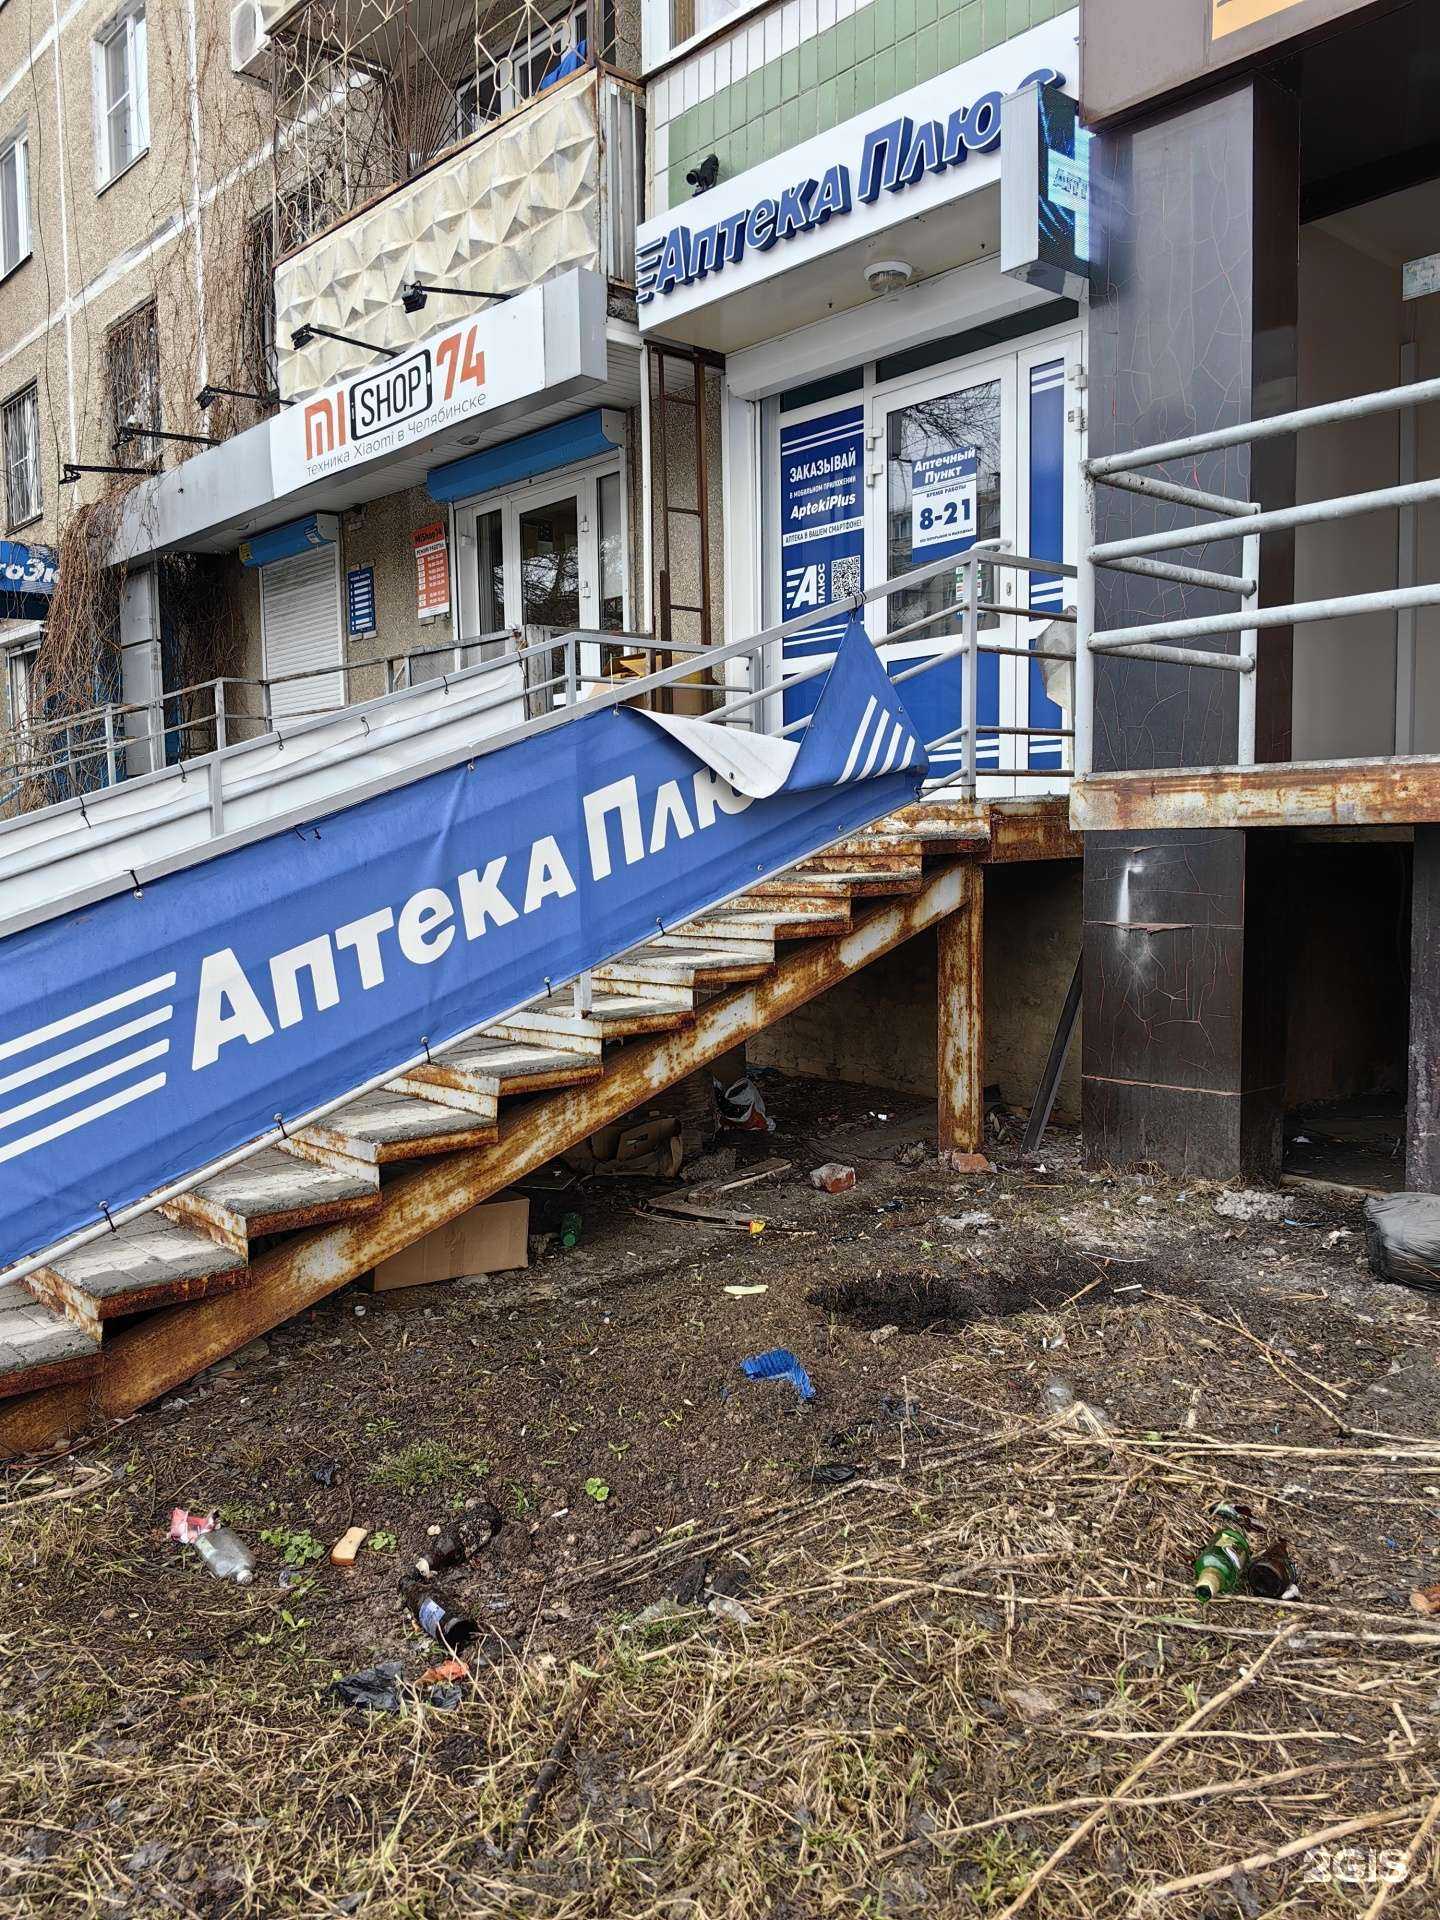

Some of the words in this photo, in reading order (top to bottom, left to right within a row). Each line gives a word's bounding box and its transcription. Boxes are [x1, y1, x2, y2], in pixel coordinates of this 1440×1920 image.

[655, 163, 852, 295] Аптека
[858, 68, 1066, 204] Плю
[361, 365, 421, 427] SHOP
[436, 324, 485, 401] 74
[306, 453, 350, 477] техника
[353, 430, 395, 459] Xiaomi
[408, 392, 487, 437] Челябинске
[789, 447, 856, 483] ЗАКАЗЫВАЙ
[913, 447, 976, 473] Аптечный
[924, 466, 963, 486] Пункт
[790, 493, 857, 521] AptekiPlus
[920, 498, 971, 530] 8-21
[785, 532, 804, 544] АПТЕКА
[808, 525, 828, 538] ВАШЕМ
[817, 562, 826, 604] ПЛЮС
[191, 834, 577, 1071] Аптека
